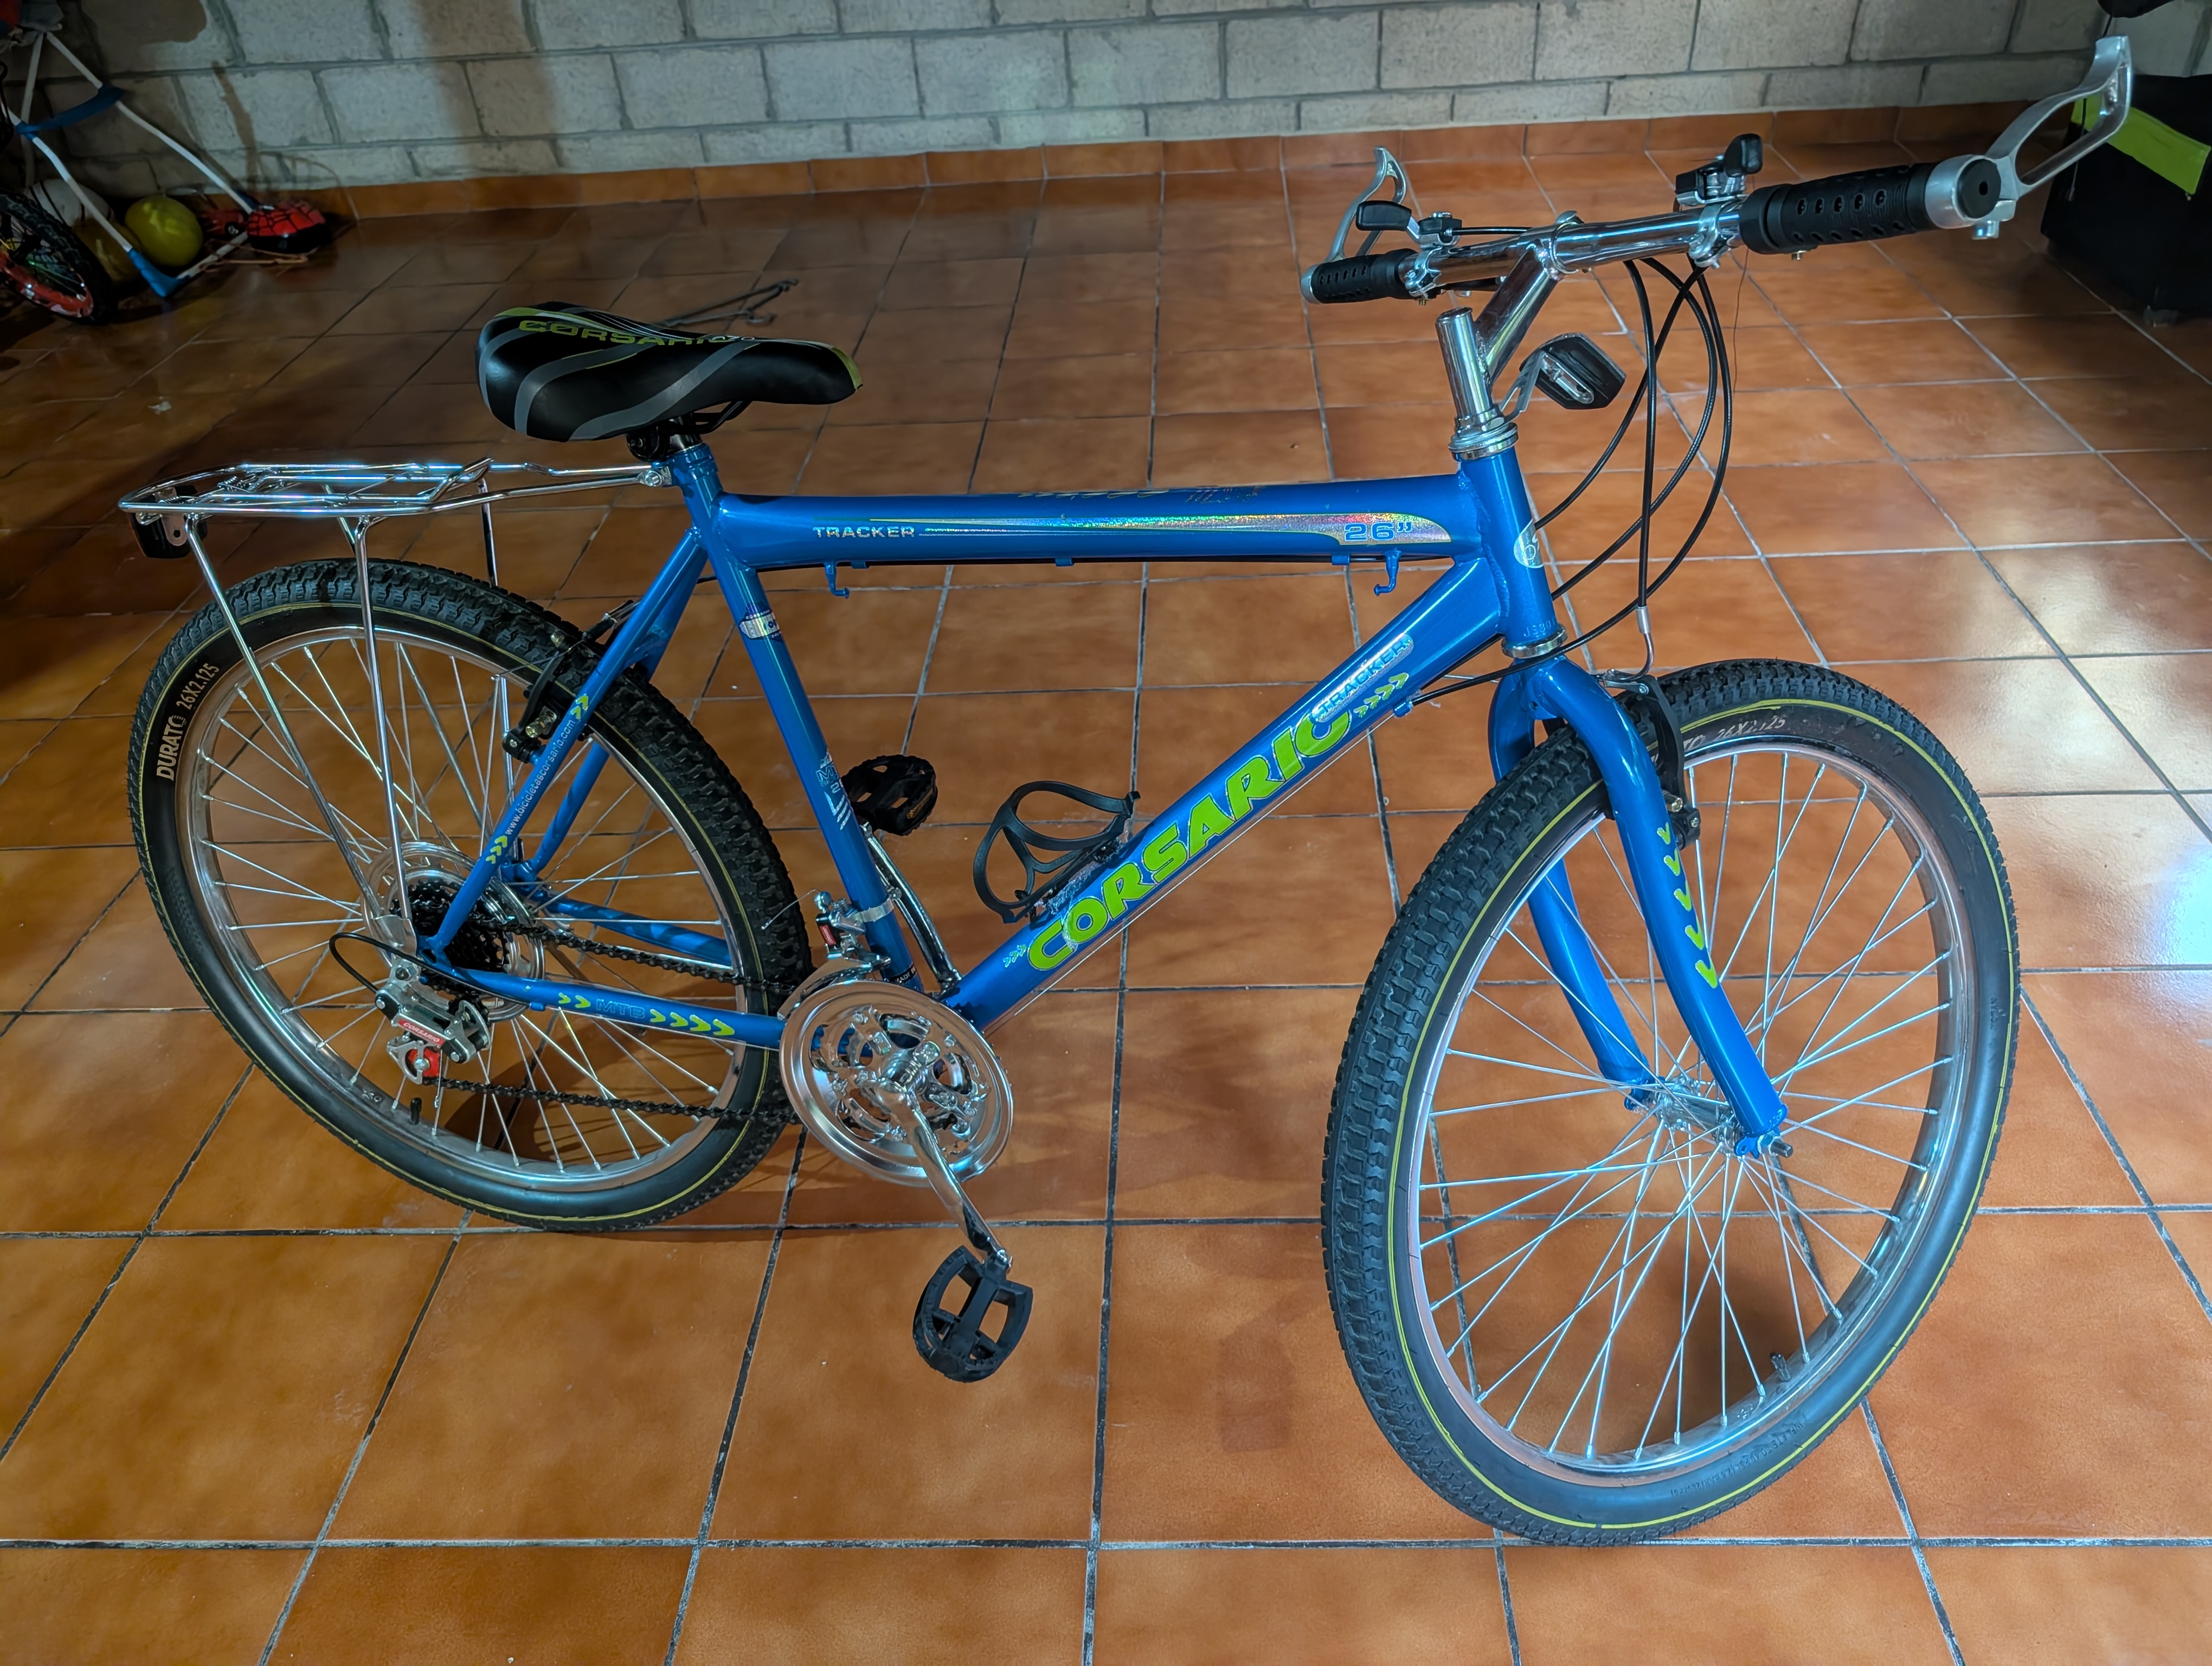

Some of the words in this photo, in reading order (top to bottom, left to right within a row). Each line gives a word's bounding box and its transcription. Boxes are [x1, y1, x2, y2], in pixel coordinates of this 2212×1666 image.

[813, 526, 915, 539] TRACKER
[176, 663, 220, 710] 26X2.125
[1317, 640, 1409, 715] TRACKER
[1028, 710, 1353, 971] CORSARIO
[596, 998, 645, 1019] MTB
[403, 1022, 440, 1042] CORSARIO
